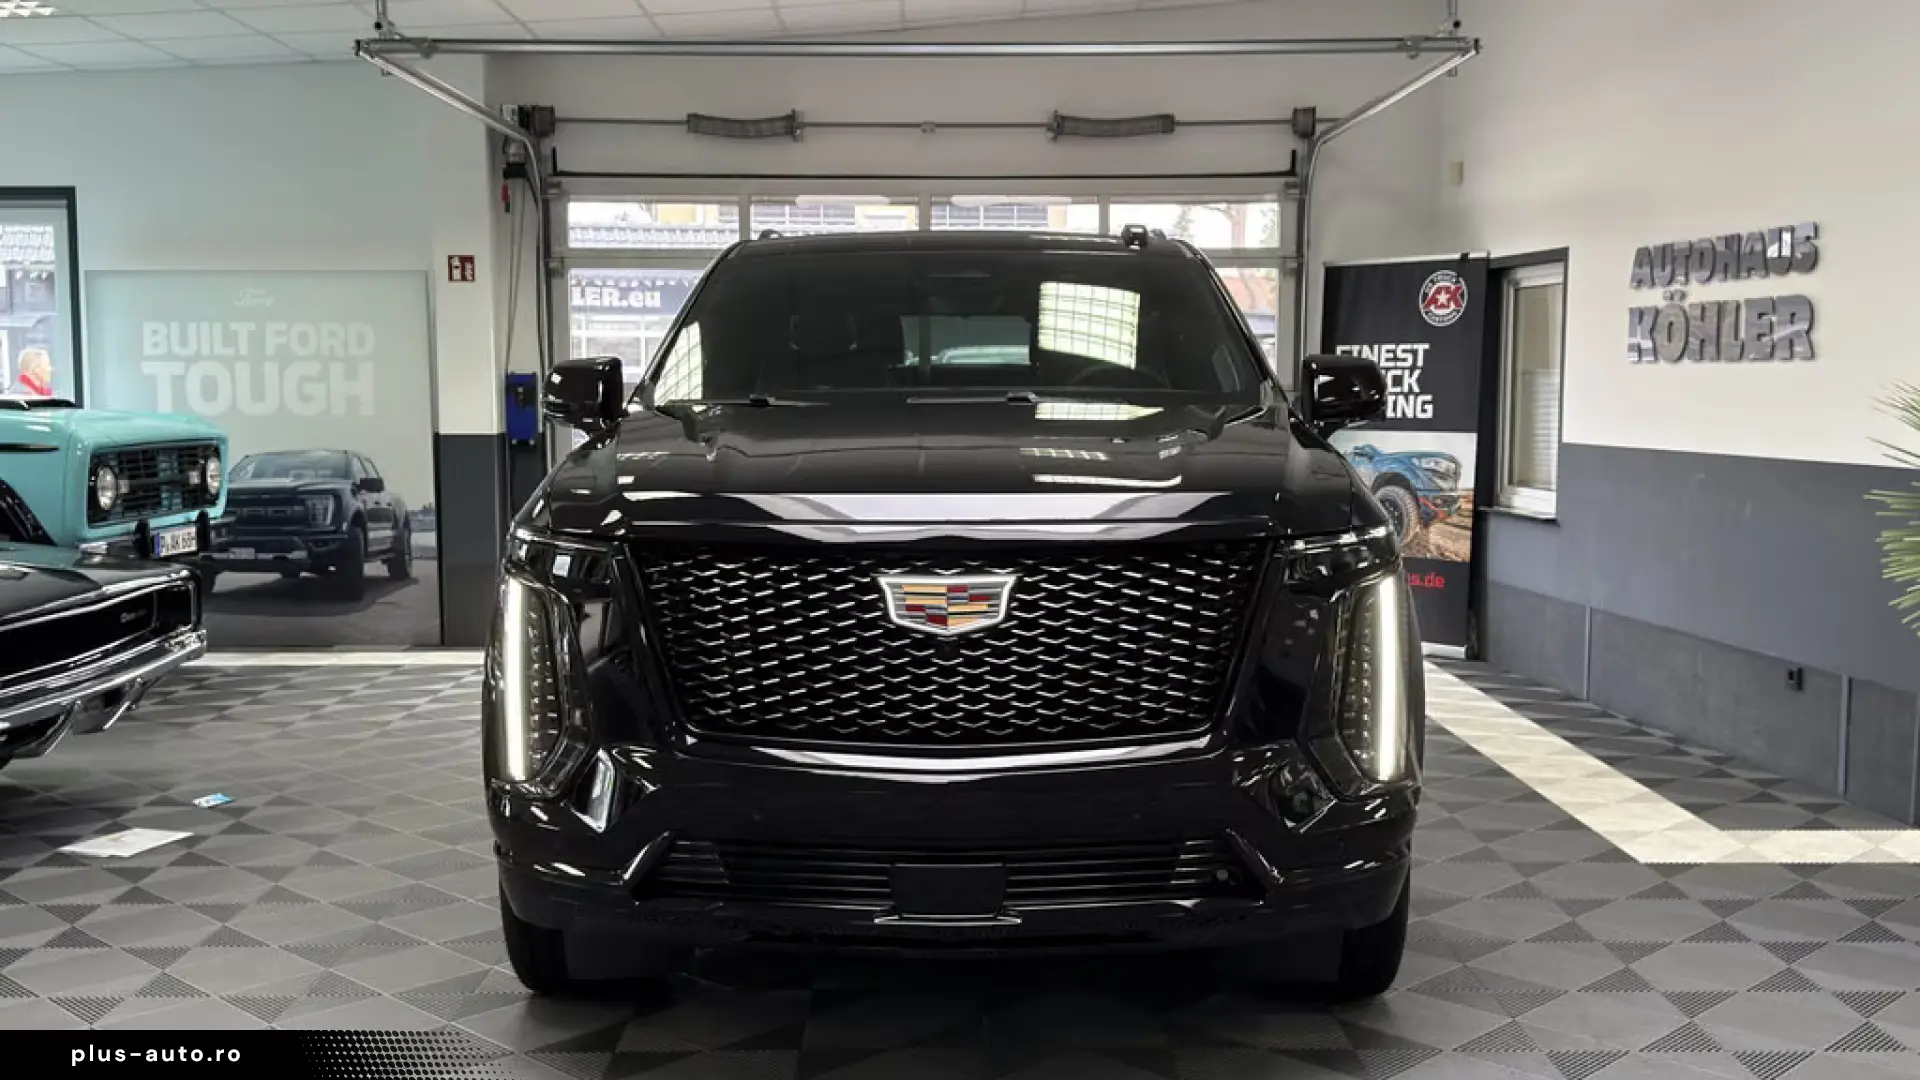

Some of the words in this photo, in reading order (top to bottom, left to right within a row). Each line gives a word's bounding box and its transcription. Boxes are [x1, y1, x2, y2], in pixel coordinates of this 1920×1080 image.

[1631, 221, 1818, 289] AUTOHAUS
[571, 286, 661, 307] LER.eu
[142, 321, 255, 357] BUILT
[265, 321, 375, 357] FORD
[1627, 288, 1815, 363] KÖHLER
[141, 360, 375, 416] TOUGH
[1385, 394, 1433, 419] ING
